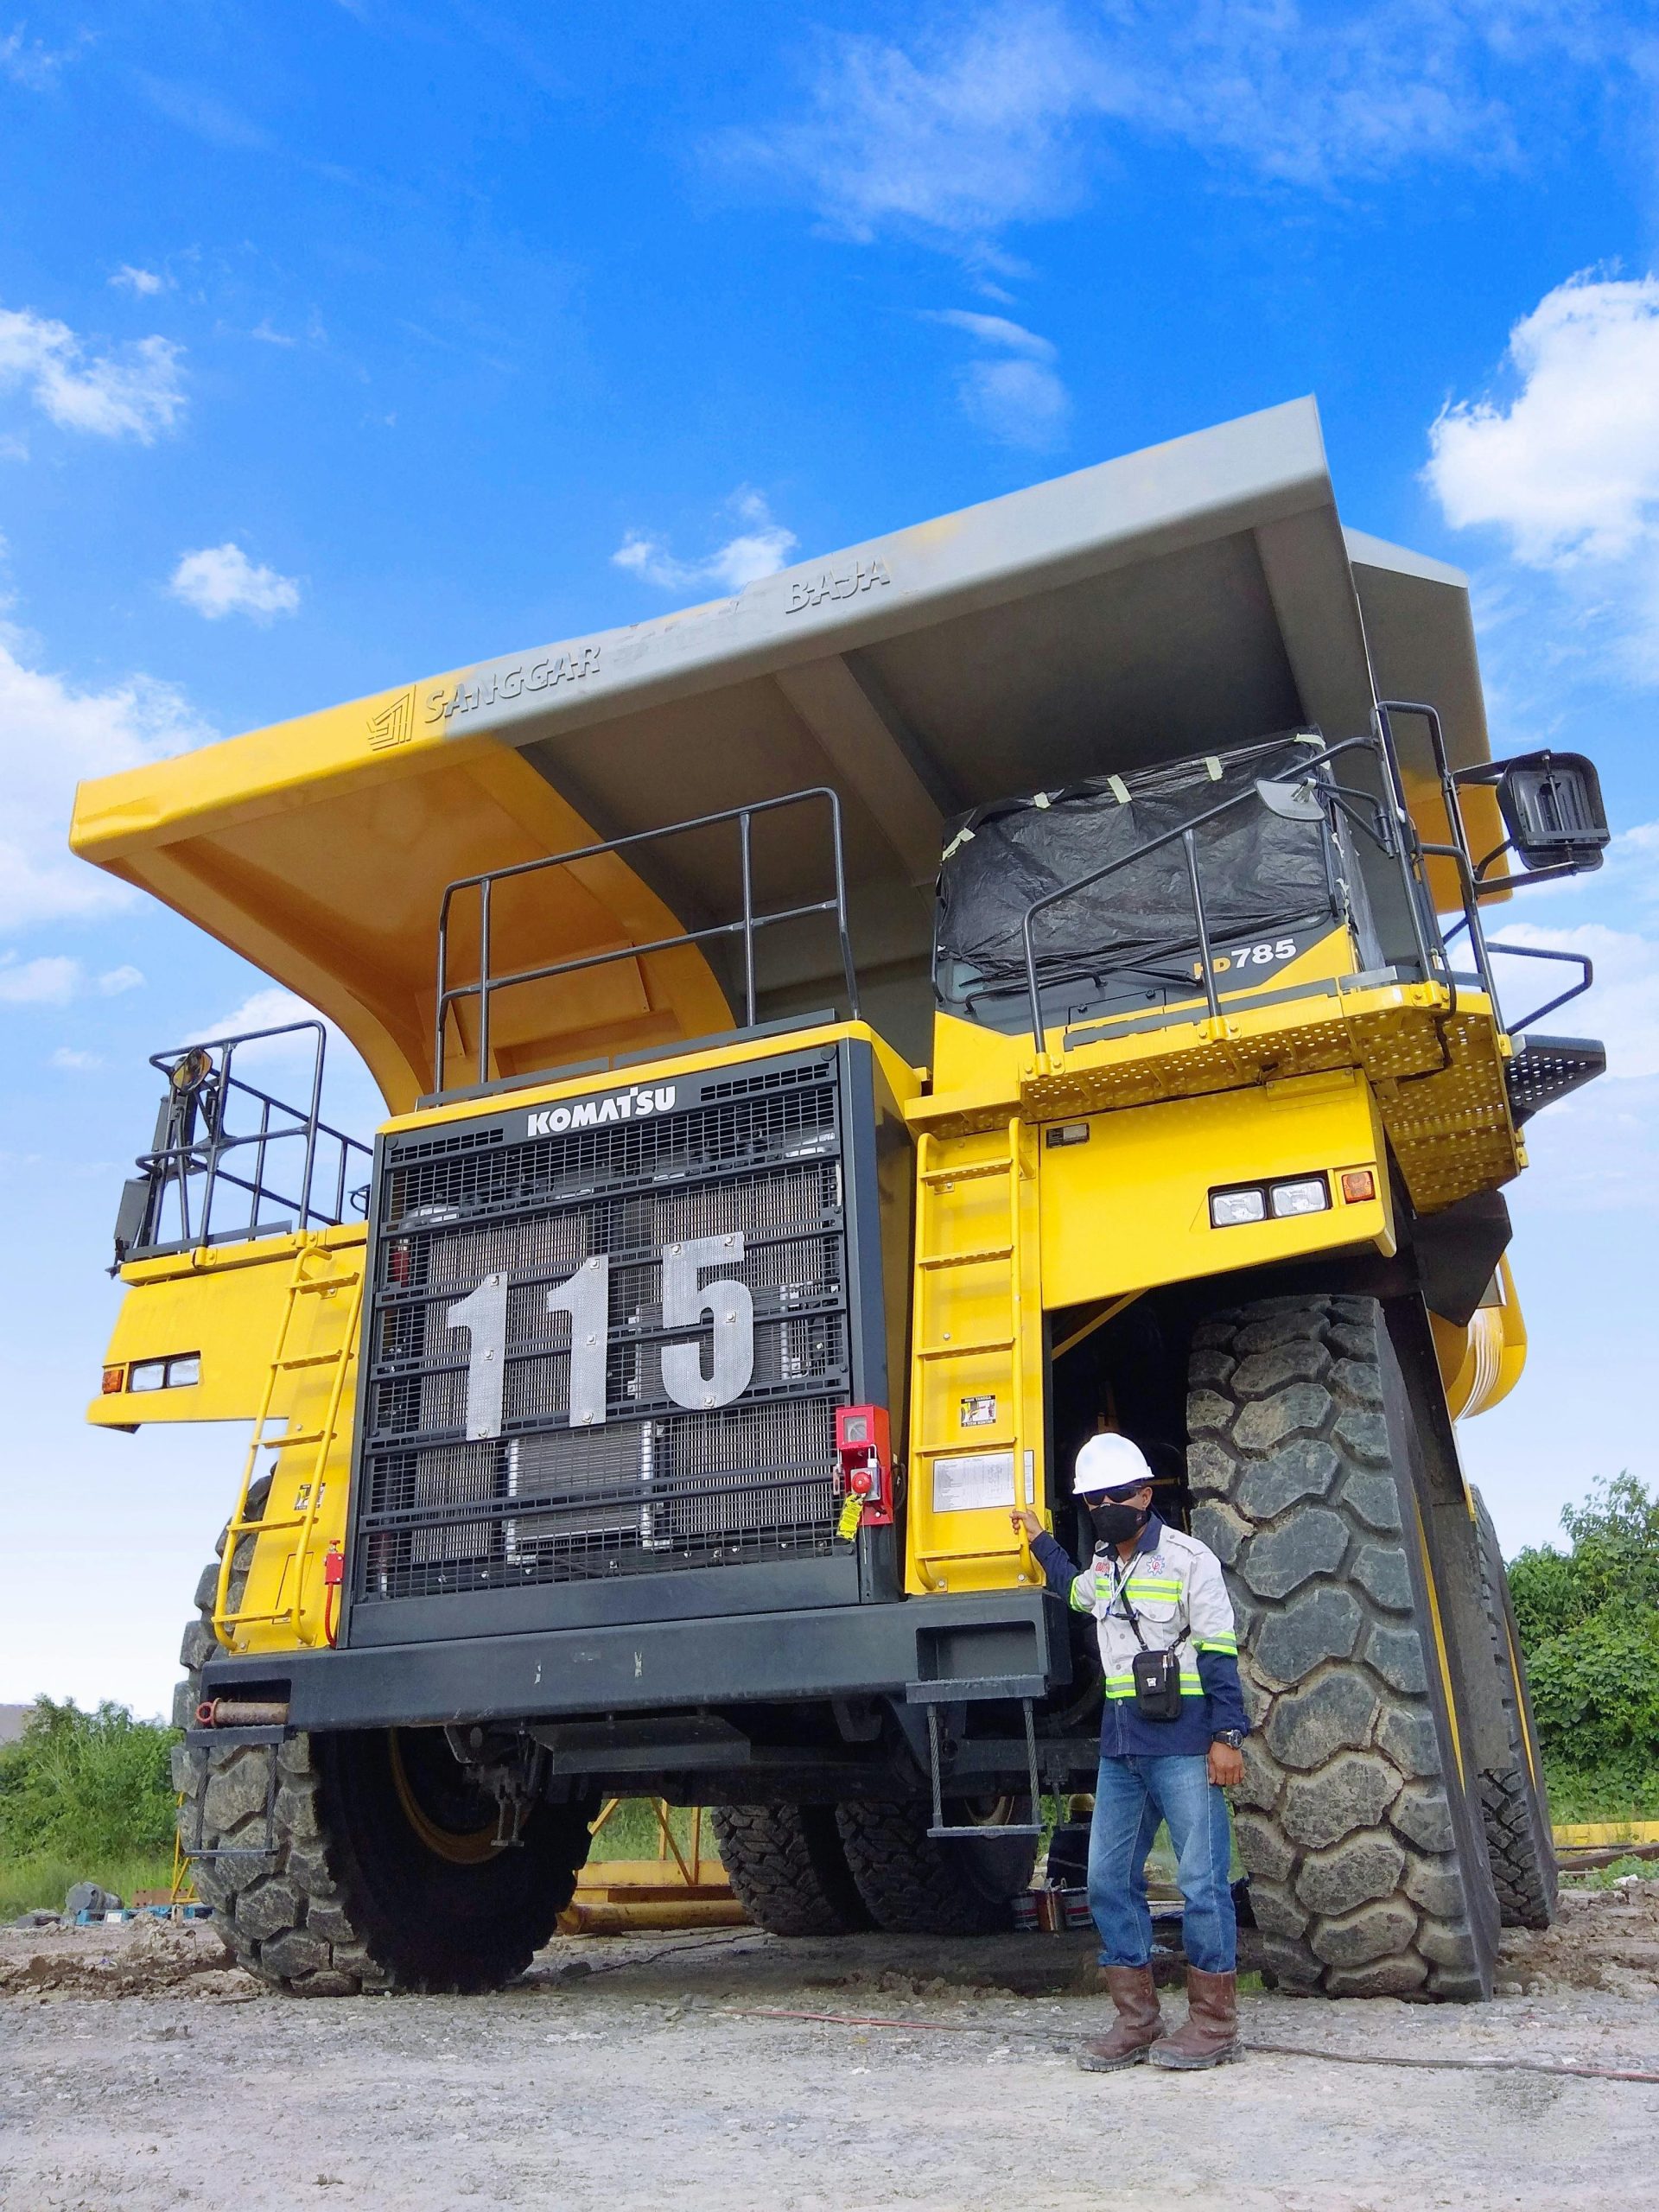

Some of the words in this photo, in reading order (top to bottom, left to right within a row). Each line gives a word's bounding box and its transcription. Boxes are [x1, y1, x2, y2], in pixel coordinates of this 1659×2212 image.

[424, 645, 601, 723] SANGGAR
[784, 559, 891, 613] BAJA
[527, 1085, 676, 1137] KOMATSU
[448, 1230, 754, 1441] 115
